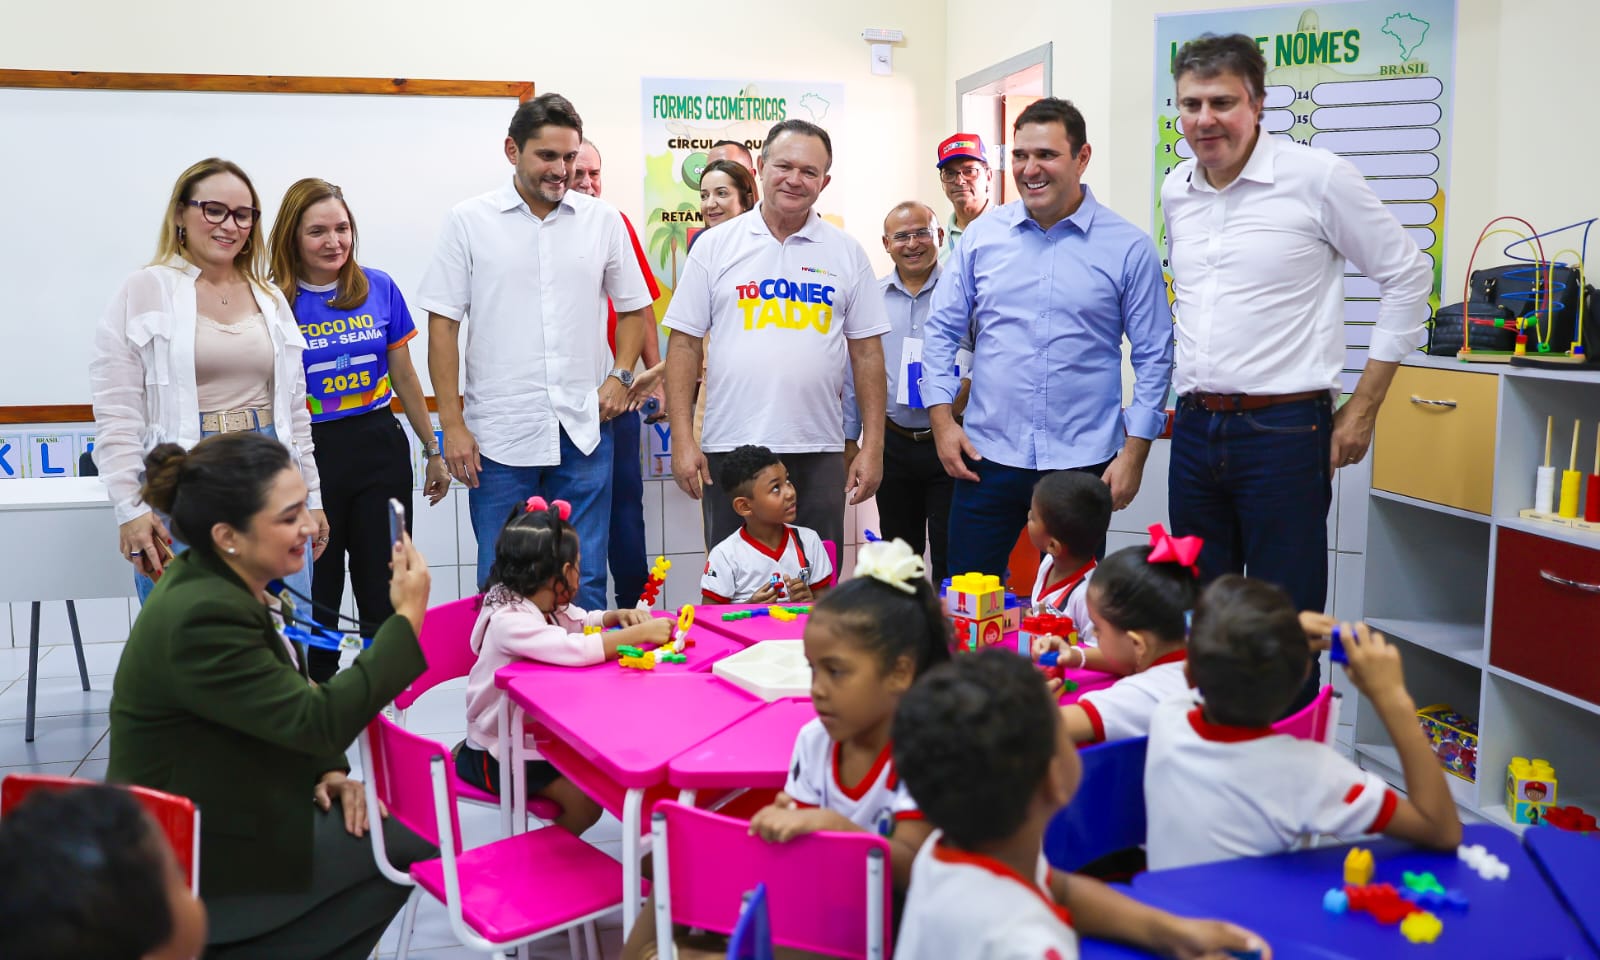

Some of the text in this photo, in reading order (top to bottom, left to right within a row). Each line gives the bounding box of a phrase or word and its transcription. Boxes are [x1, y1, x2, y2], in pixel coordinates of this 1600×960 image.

[1275, 29, 1360, 66] NOMES
[1379, 63, 1427, 75] BRASIL
[1297, 91, 1309, 100] 14
[653, 90, 787, 121] FORMAS GEOMÉTRICAS
[1165, 121, 1172, 129] 2
[1297, 114, 1308, 124] 15
[668, 136, 714, 149] CÍRCUL
[1165, 144, 1171, 153] 3
[662, 209, 704, 222] RETÂN
[737, 298, 833, 335] TADO
[298, 314, 374, 338] FOCO NO
[339, 328, 383, 345] SEAMA
[322, 370, 371, 394] 2025
[654, 424, 671, 451] Y
[40, 443, 65, 474] L
